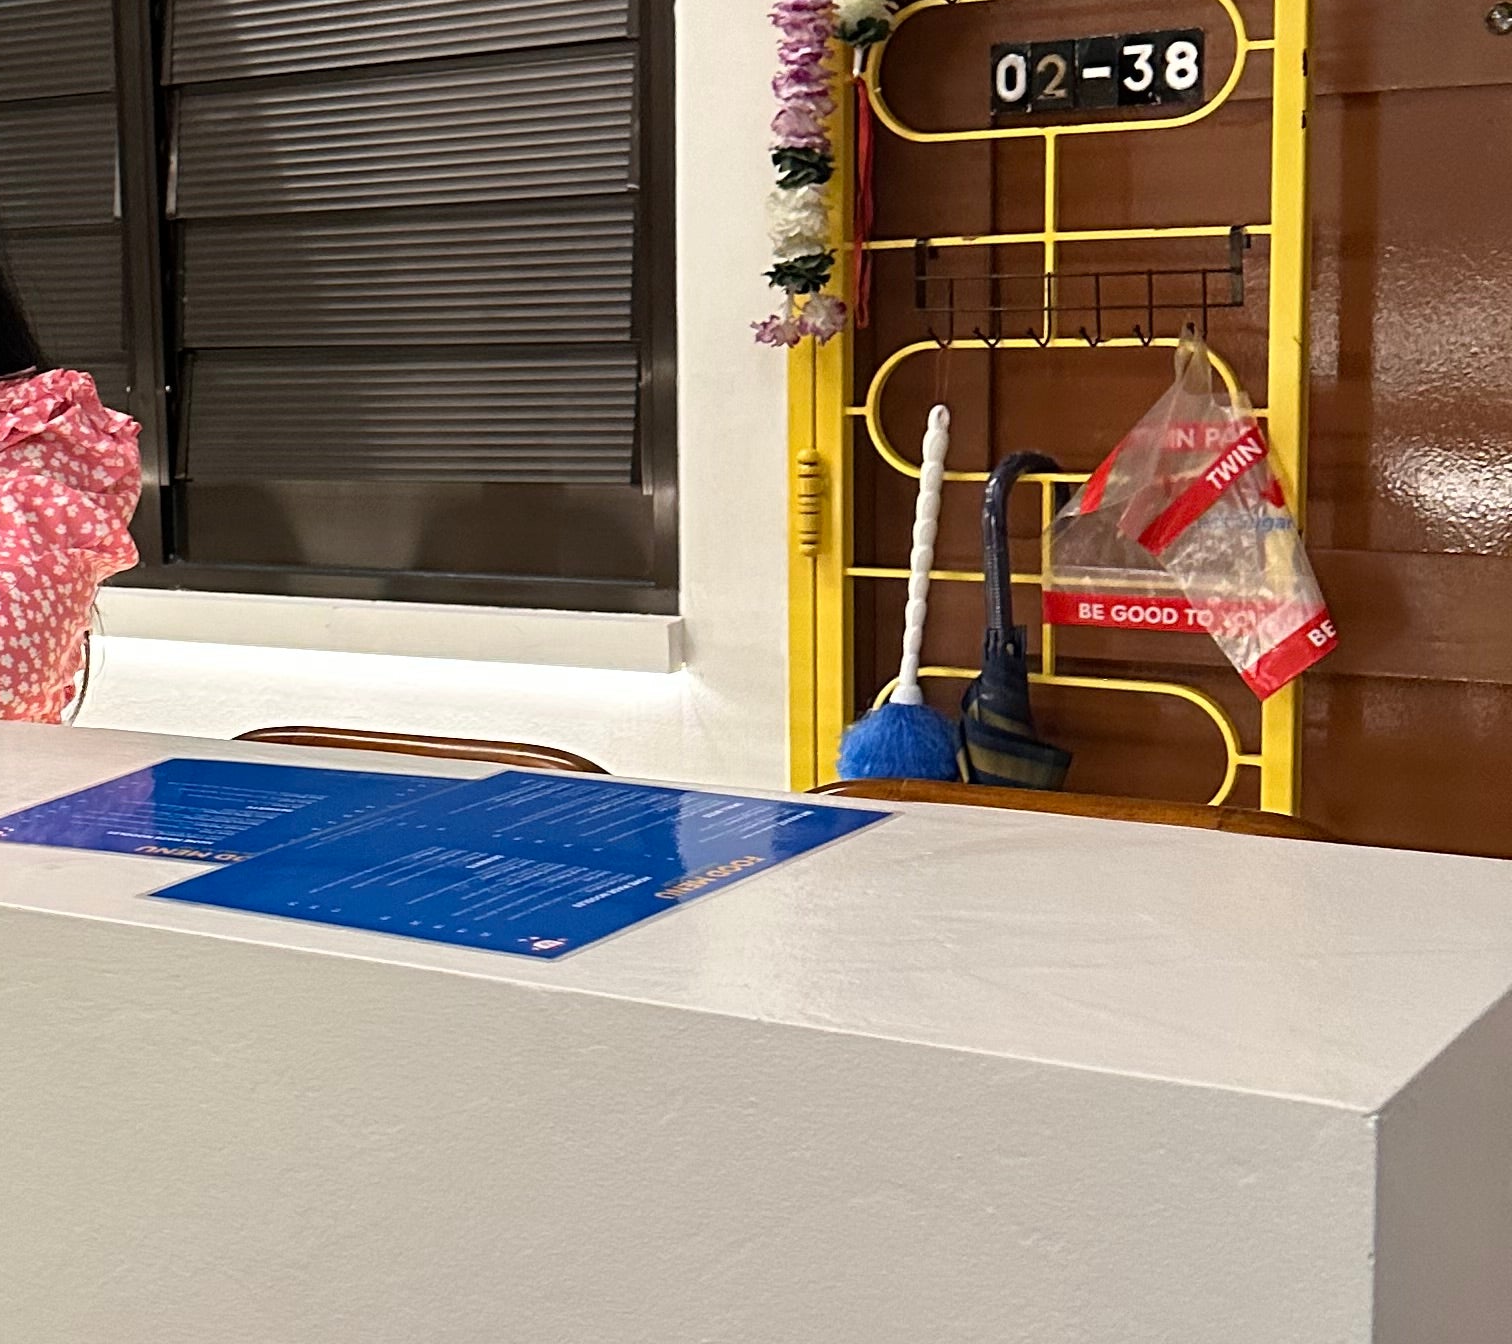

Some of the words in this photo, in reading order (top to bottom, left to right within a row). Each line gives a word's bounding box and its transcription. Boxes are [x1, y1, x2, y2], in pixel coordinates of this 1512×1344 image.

[996, 40, 1199, 103] 02-38
[1205, 437, 1263, 490] TWIN
[1079, 603, 1105, 621] BE
[1110, 605, 1179, 625] GOOD
[1184, 608, 1215, 628] TO
[1307, 619, 1337, 648] BE
[134, 845, 213, 859] MENU
[705, 856, 767, 877] FOOD
[653, 876, 717, 899] MENU
